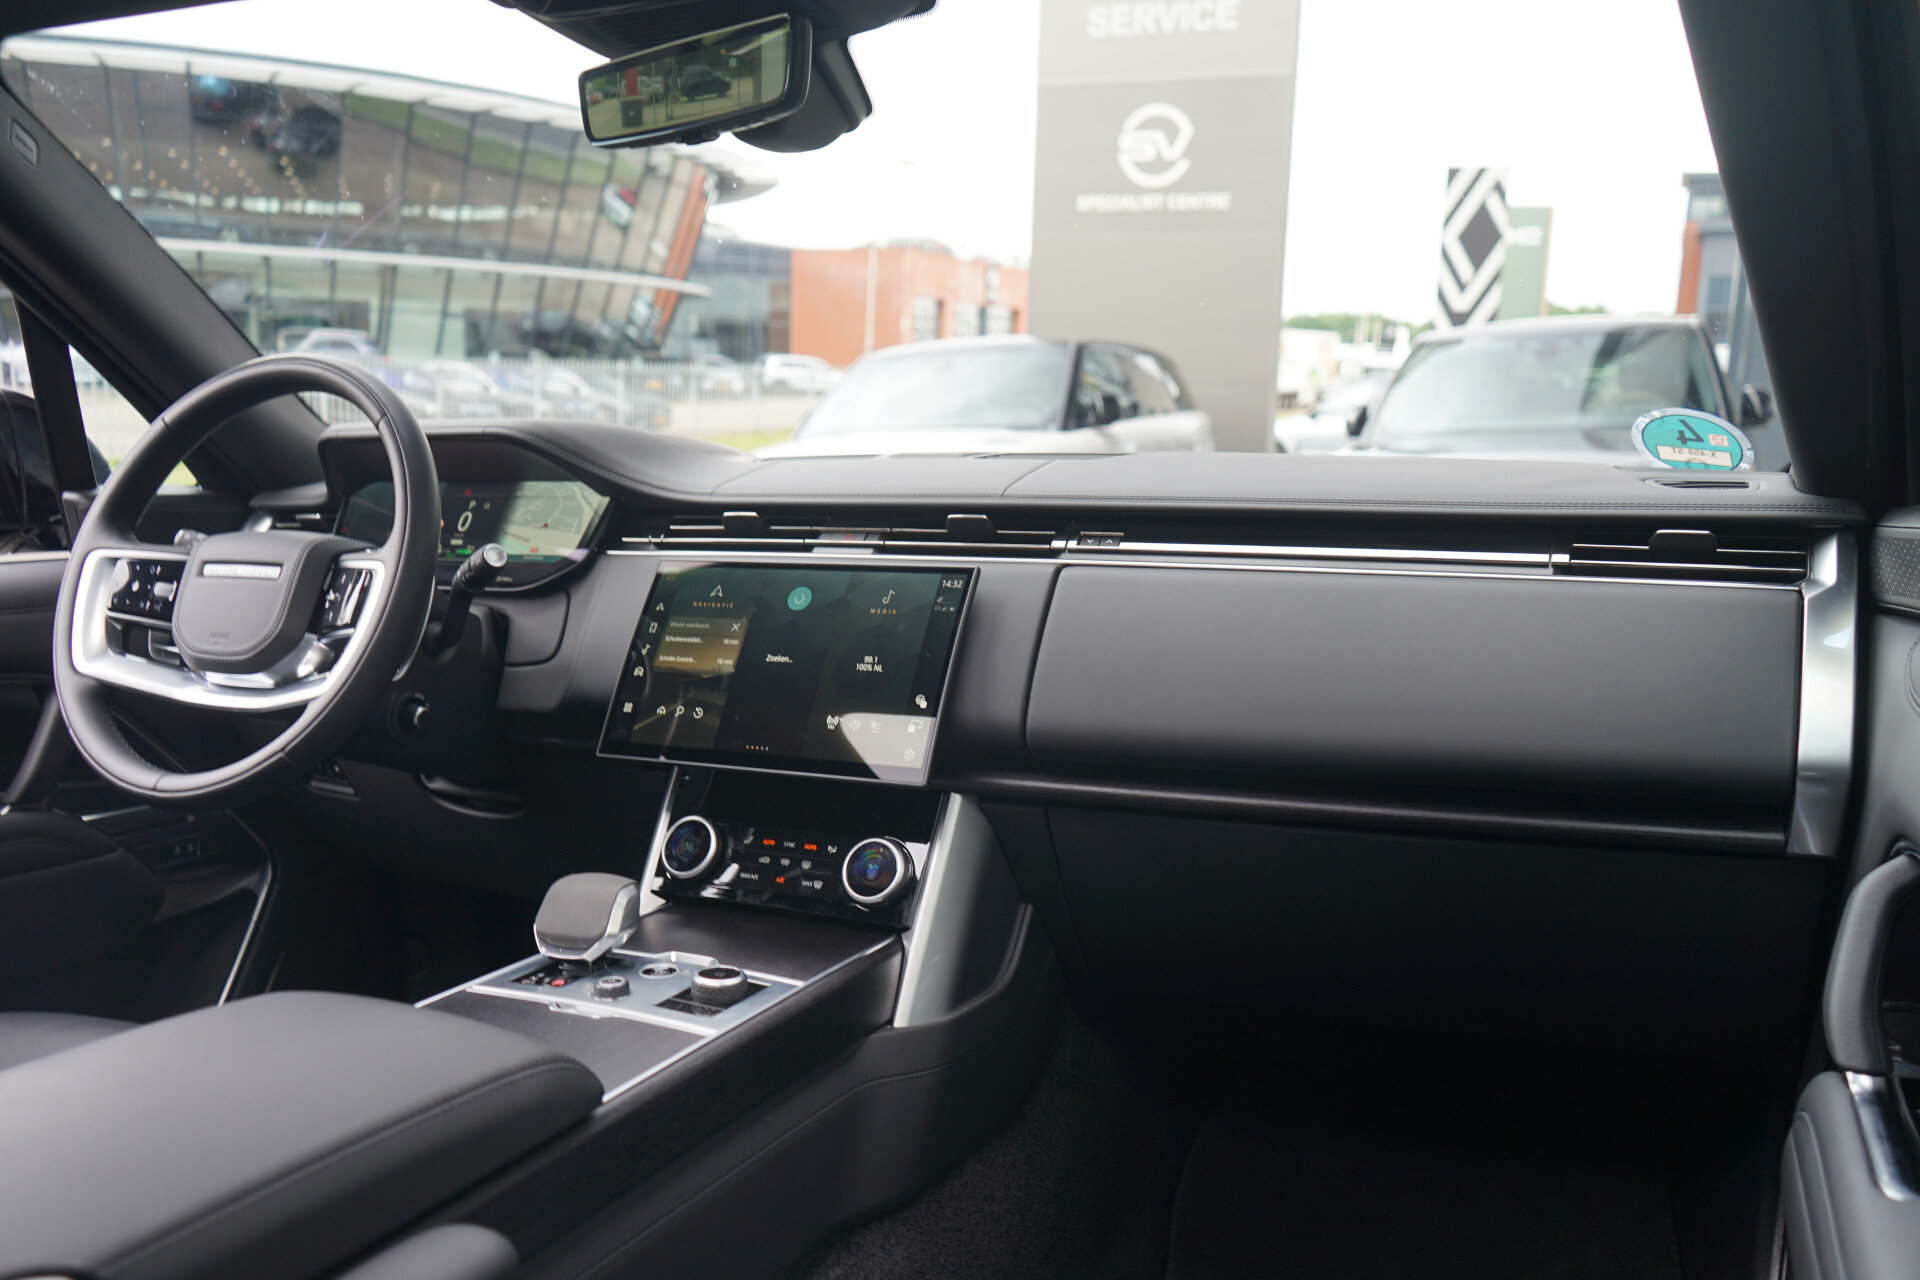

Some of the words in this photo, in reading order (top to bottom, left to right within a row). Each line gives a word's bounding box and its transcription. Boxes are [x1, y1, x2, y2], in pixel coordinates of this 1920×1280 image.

[1086, 0, 1242, 37] SERVICE
[1076, 192, 1164, 212] SPECIALIST
[1166, 191, 1232, 212] CENTRE
[457, 511, 473, 533] 0
[942, 579, 963, 589] 14:32
[692, 601, 735, 609] NAVIGATIE
